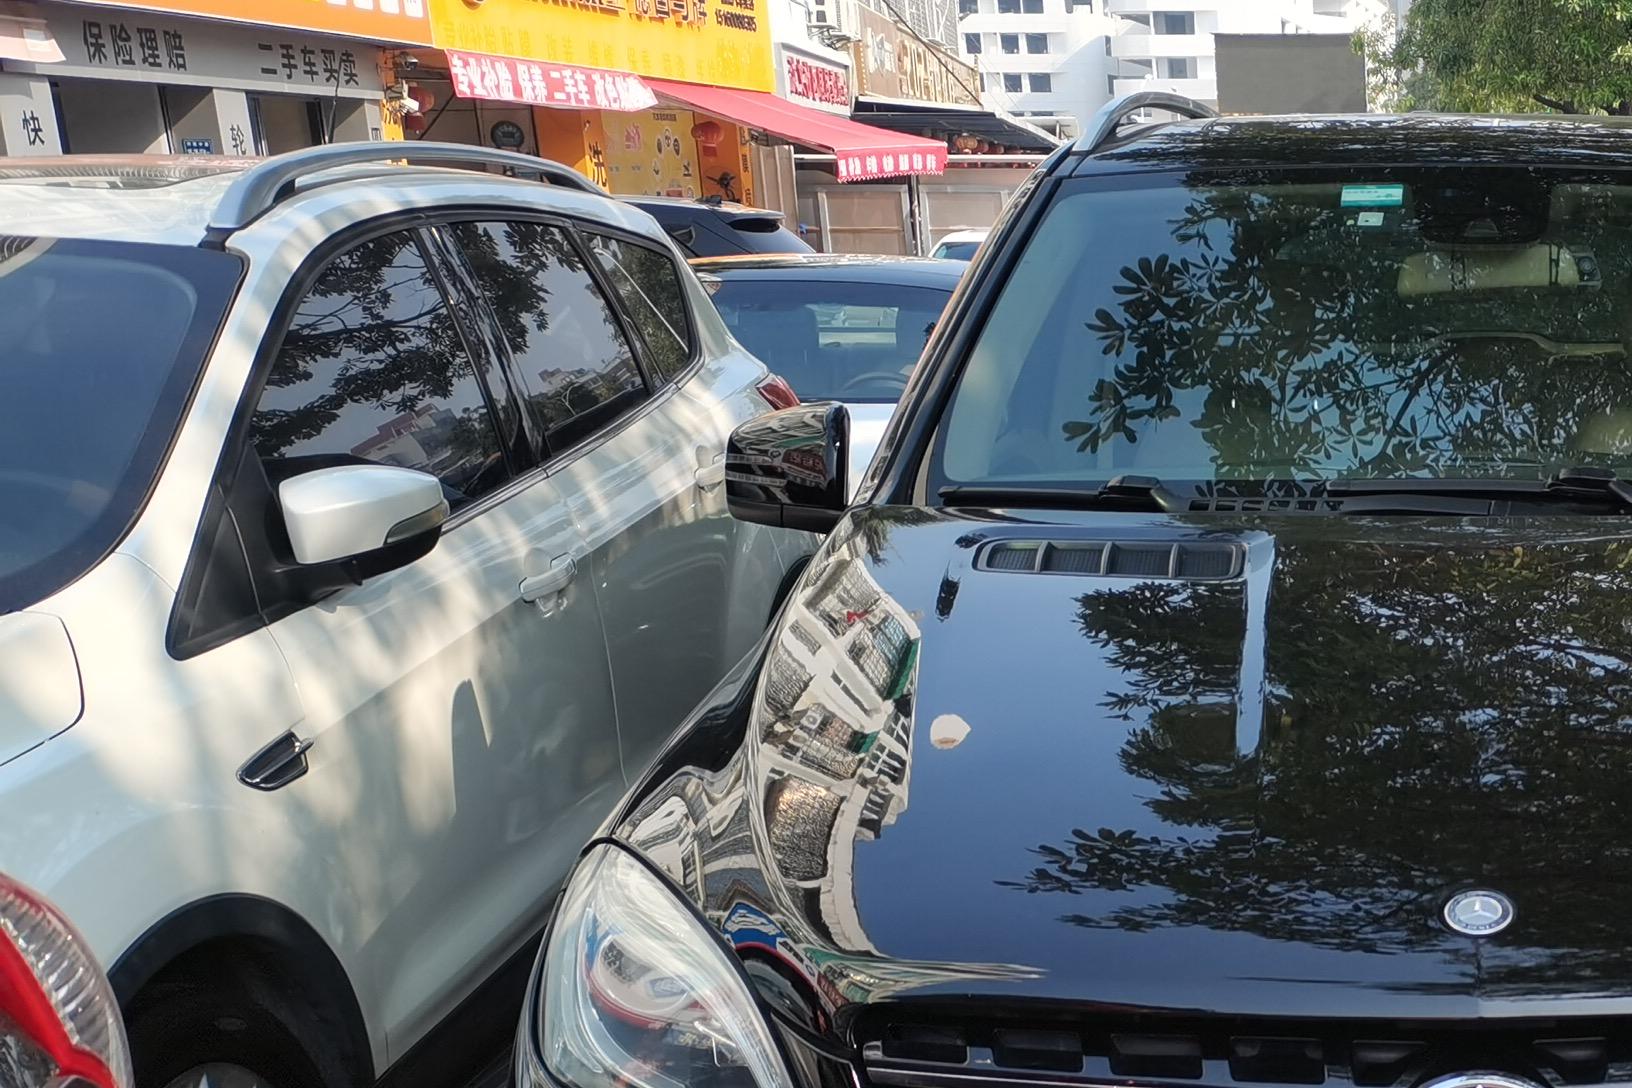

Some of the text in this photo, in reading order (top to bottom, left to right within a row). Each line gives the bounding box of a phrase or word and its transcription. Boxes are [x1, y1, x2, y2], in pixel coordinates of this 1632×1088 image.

[82, 19, 188, 71] 保险理赔
[257, 42, 360, 86] 二手车买卖
[451, 54, 514, 99] 专业补胎
[516, 61, 548, 102] 保养
[550, 68, 591, 106] 二手车
[22, 109, 46, 147] 快
[229, 123, 247, 156] 轮
[588, 141, 608, 187] 洗
